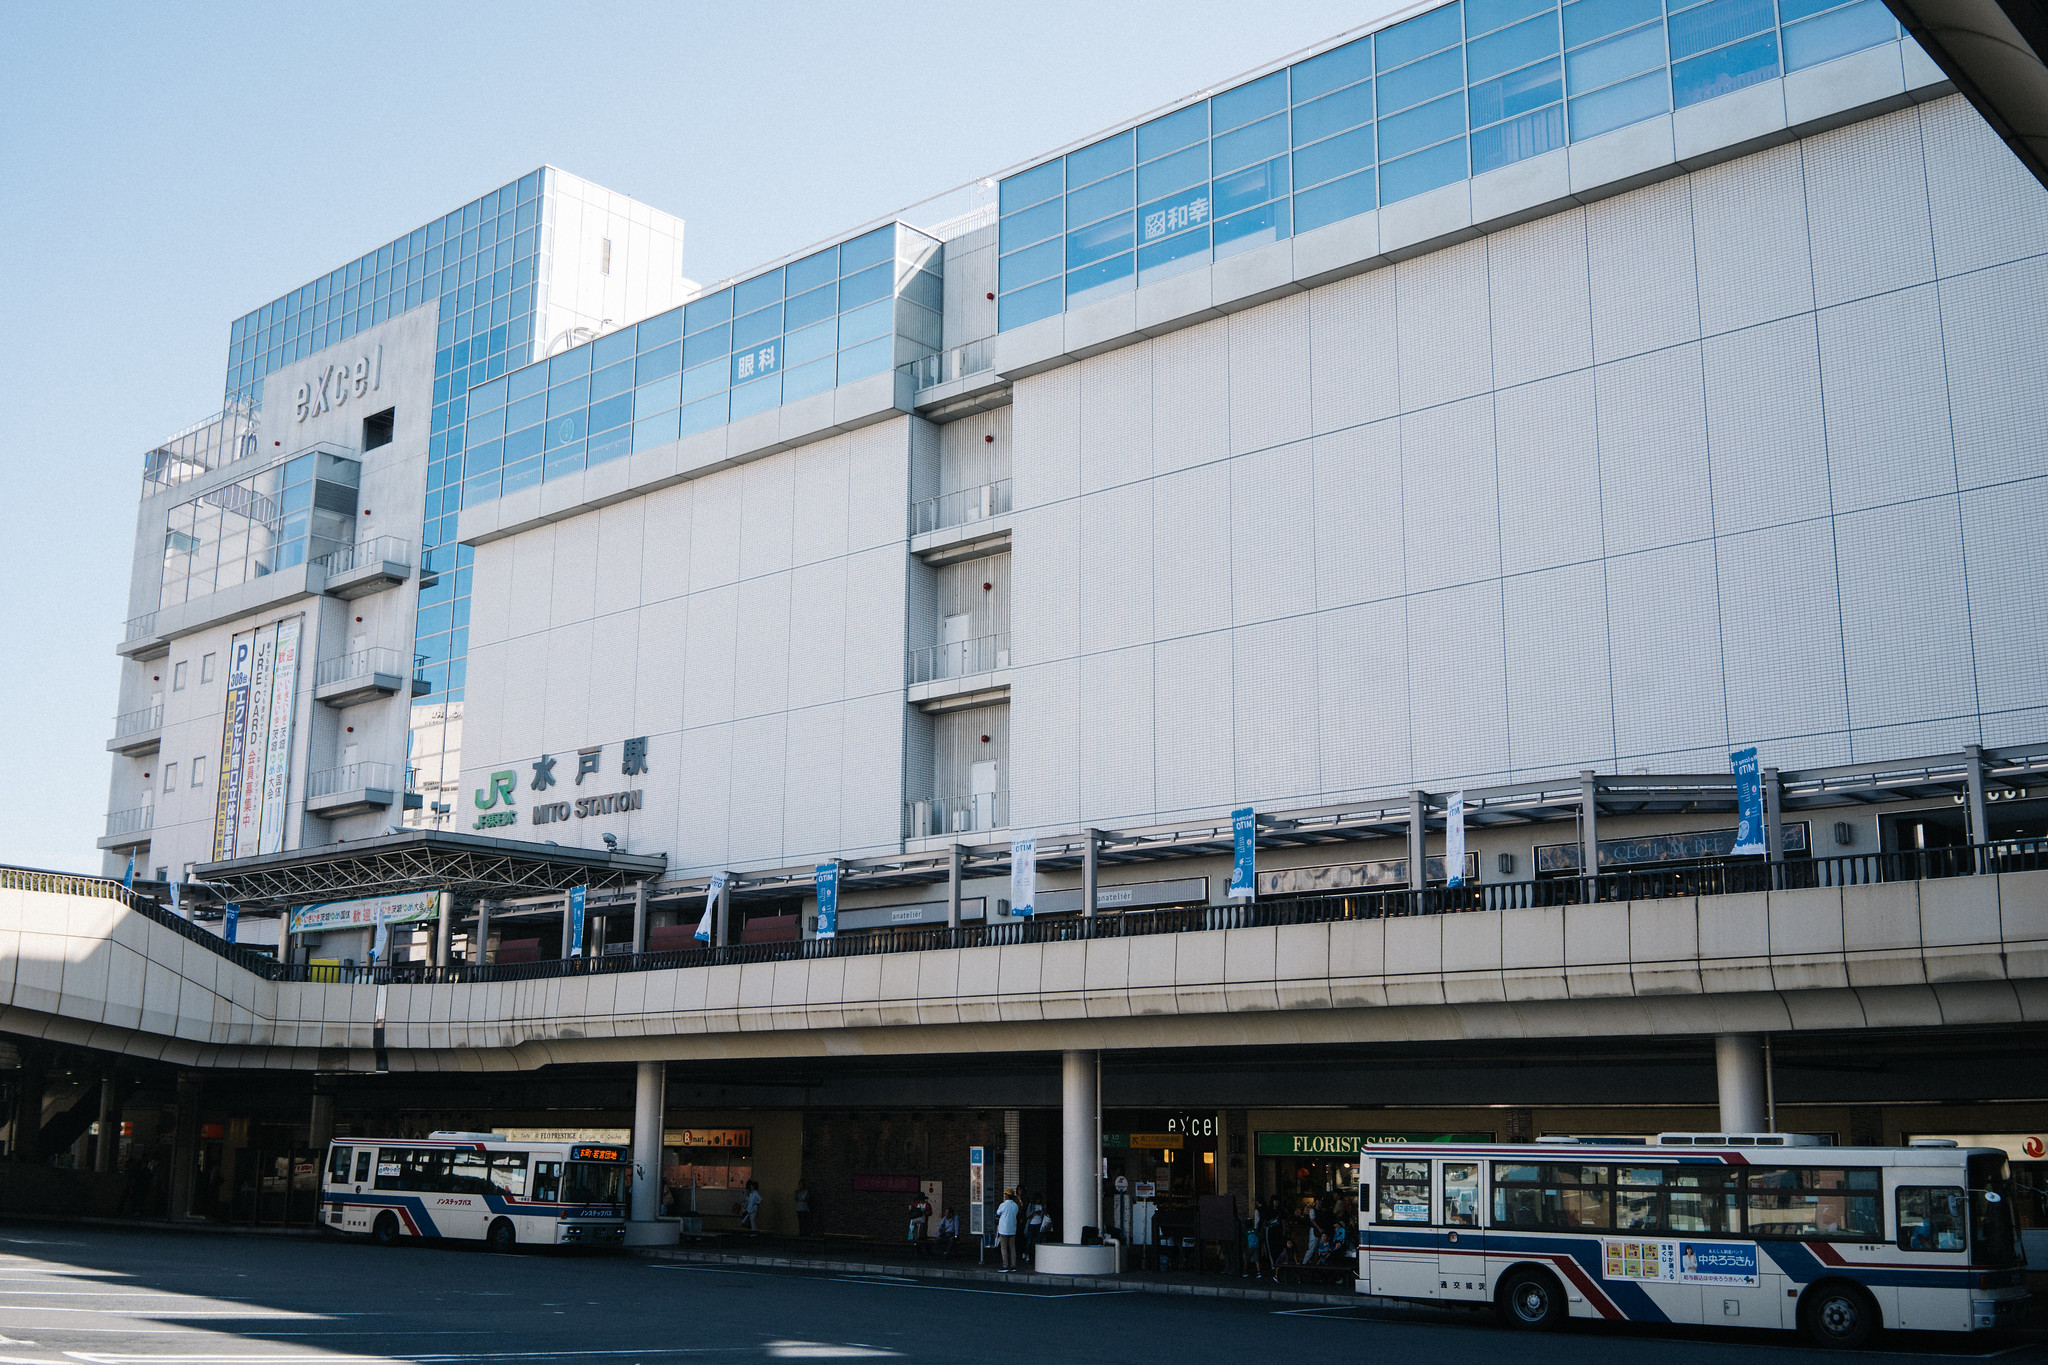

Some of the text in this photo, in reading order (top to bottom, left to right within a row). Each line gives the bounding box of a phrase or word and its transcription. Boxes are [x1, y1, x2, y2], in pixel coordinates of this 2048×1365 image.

[738, 345, 775, 379] 眼科
[236, 644, 248, 671] P
[278, 648, 295, 664] 歓迎
[250, 643, 266, 745] JRE CARD
[531, 736, 649, 791] 水戸駅
[242, 749, 256, 829] 会員募集中
[474, 769, 516, 810] JR
[532, 789, 643, 826] MITO STATION
[1613, 843, 1660, 861] CECIL
[1698, 838, 1724, 852] BEE
[303, 910, 351, 924] いきいき茨城ゆめ国体
[353, 908, 371, 922] 歓迎
[1293, 1136, 1361, 1153] FLORIST
[973, 1152, 980, 1161] 4
[436, 1198, 472, 1207] ノンステップバス
[580, 1210, 613, 1218] ノンステップバス
[1667, 1244, 1675, 1280] 数字が選べる
[1698, 1254, 1755, 1268] 中央ろうきん
